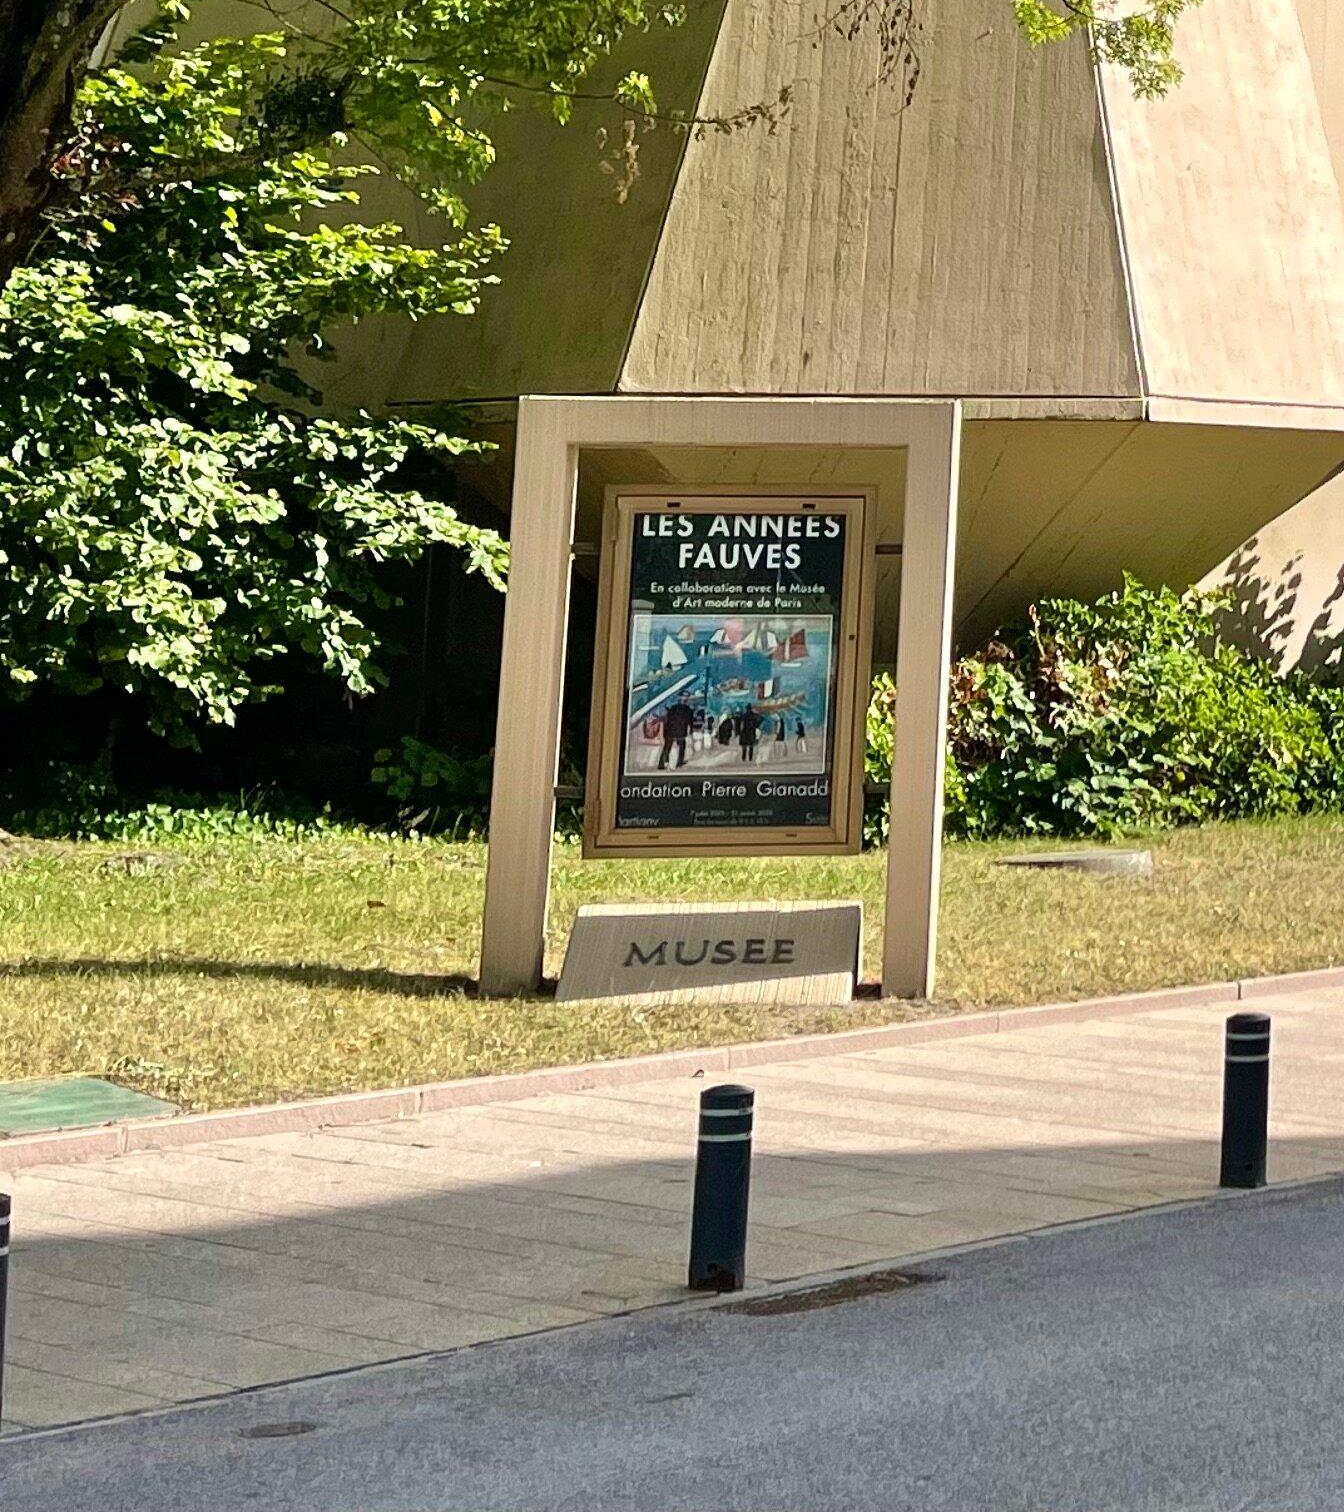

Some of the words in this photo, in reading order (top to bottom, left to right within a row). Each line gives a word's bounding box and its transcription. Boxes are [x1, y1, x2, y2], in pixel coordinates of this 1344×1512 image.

[642, 514, 694, 537] LES
[678, 543, 802, 570] FAUVES
[650, 581, 664, 594] En
[667, 581, 743, 594] collaboration
[746, 584, 772, 594] avec
[776, 582, 787, 594] le
[672, 596, 702, 609] d'Art
[704, 596, 753, 609] moderne
[756, 596, 771, 609] de
[774, 596, 802, 609] Paris
[620, 782, 692, 799] ondation
[701, 781, 747, 798] Pierre
[756, 779, 829, 797] Gianadd
[623, 938, 796, 968] MUSEE
